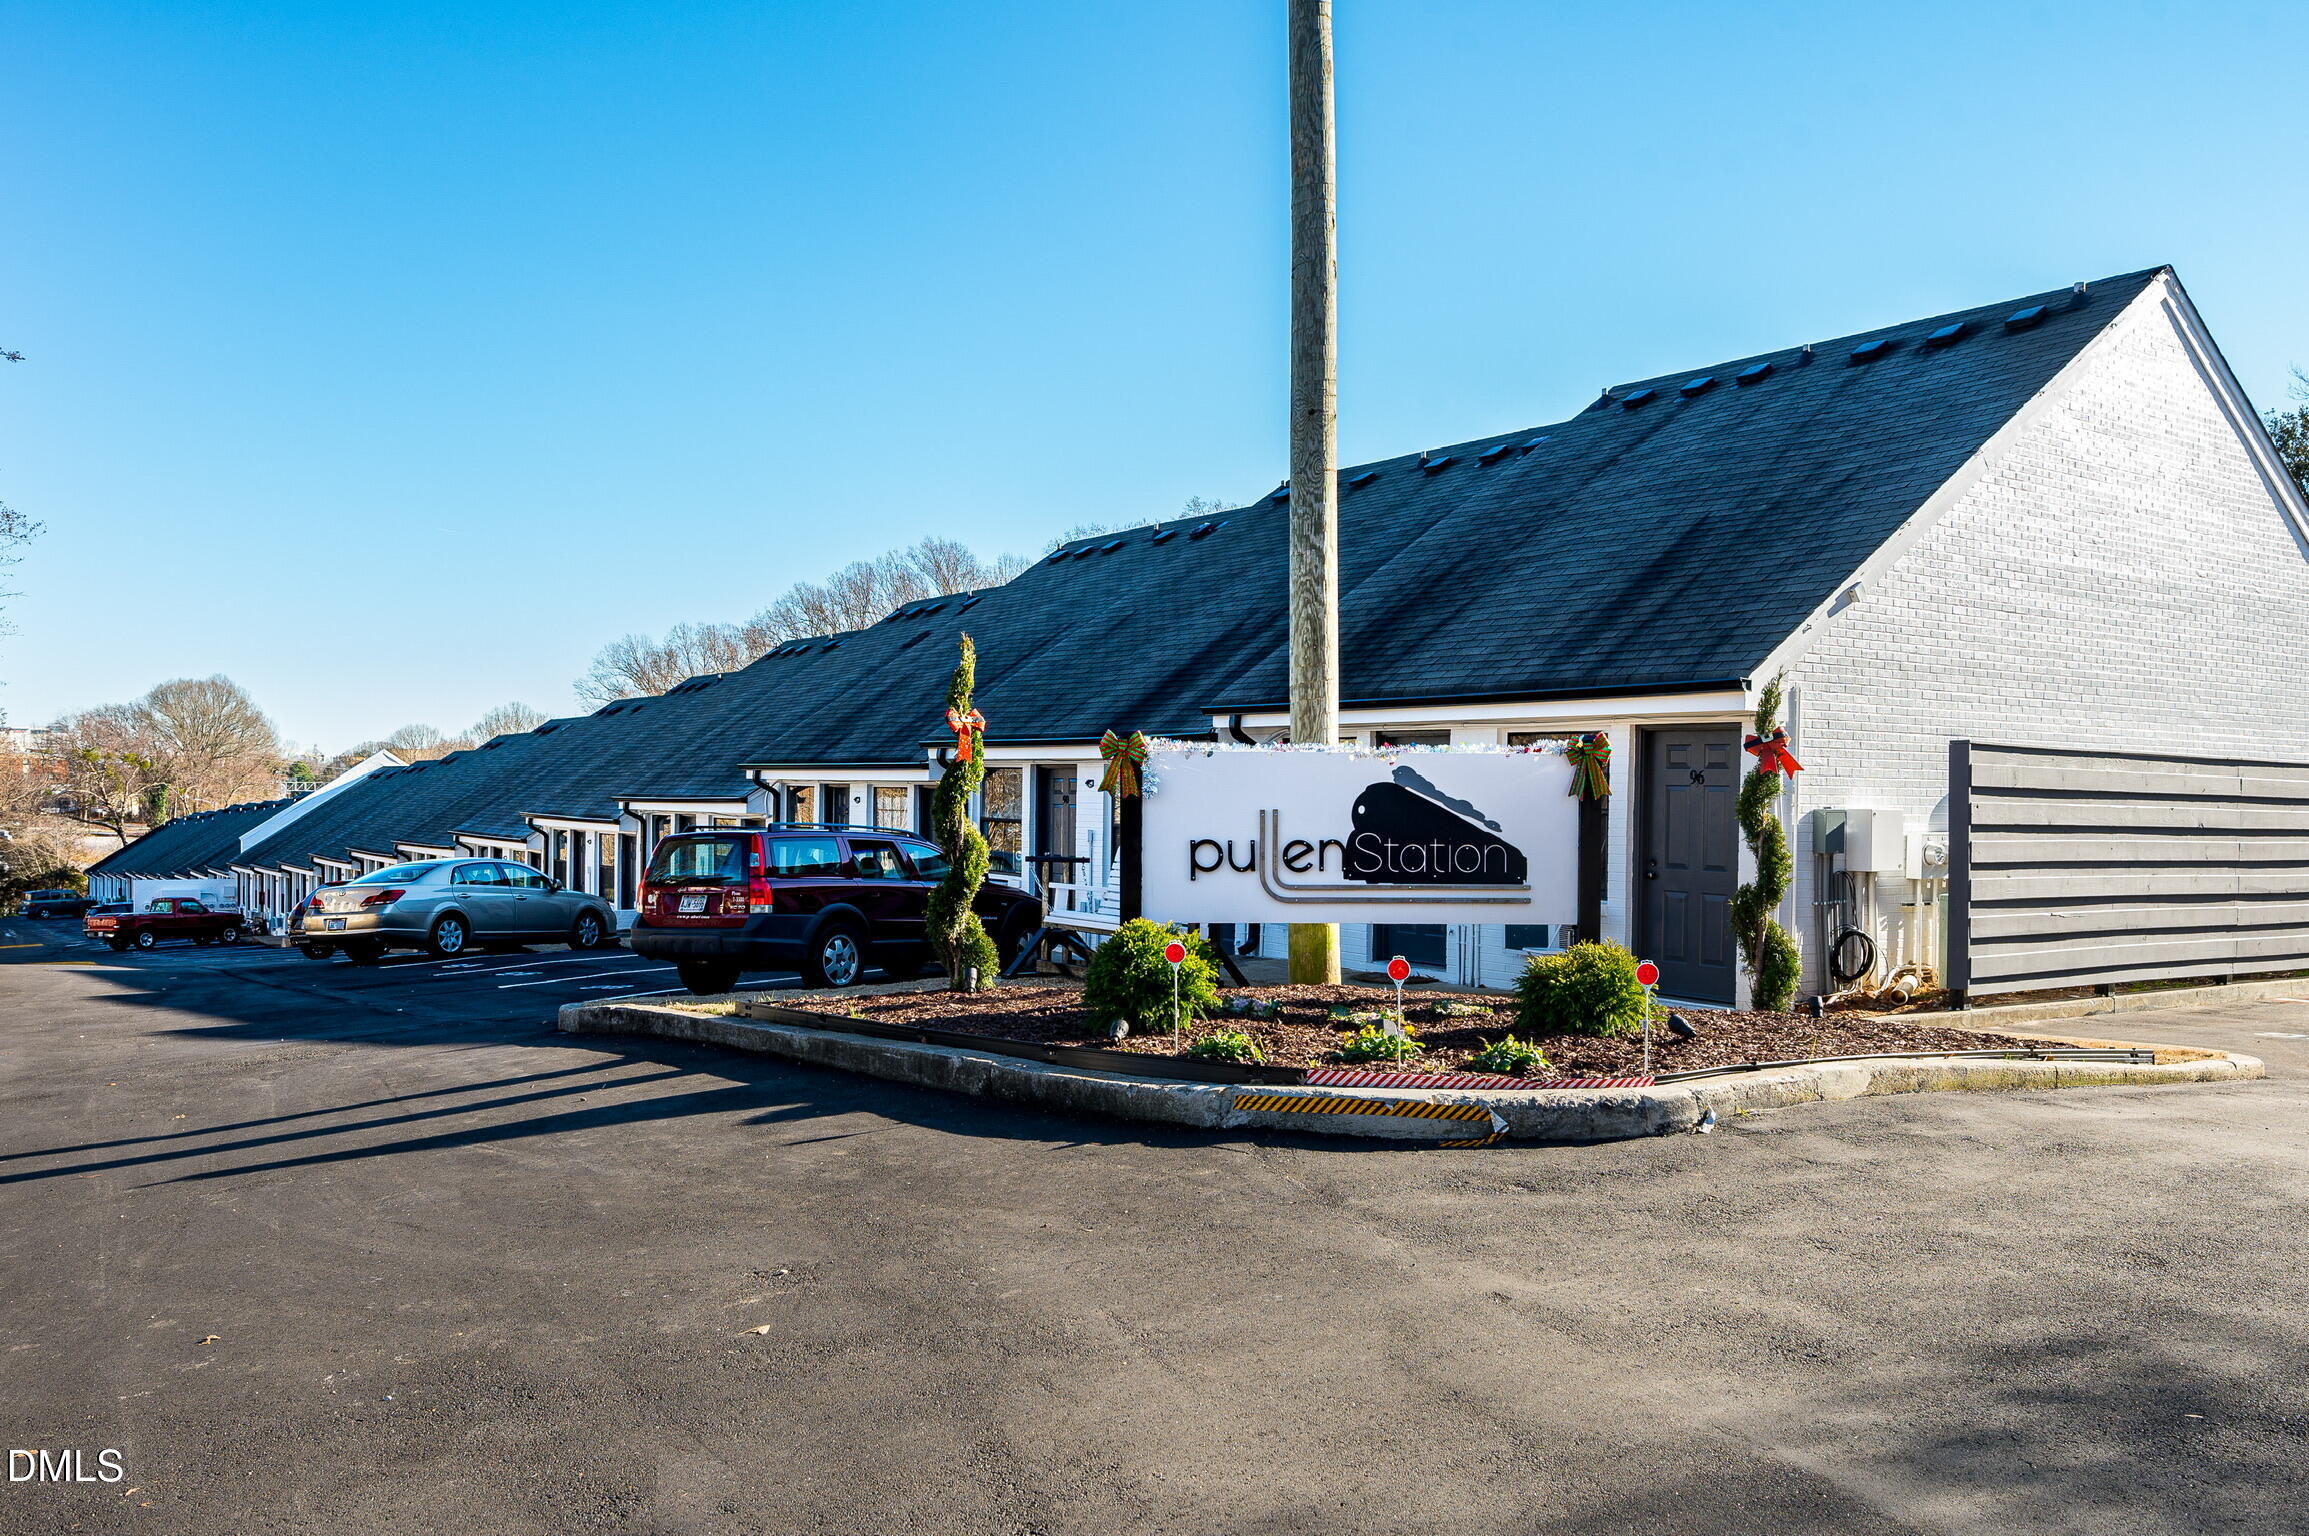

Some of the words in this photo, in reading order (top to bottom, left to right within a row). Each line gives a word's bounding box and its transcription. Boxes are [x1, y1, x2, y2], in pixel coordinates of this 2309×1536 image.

[1690, 769, 1705, 785] 96
[1189, 809, 1347, 886] pullen
[1354, 832, 1507, 873] Station
